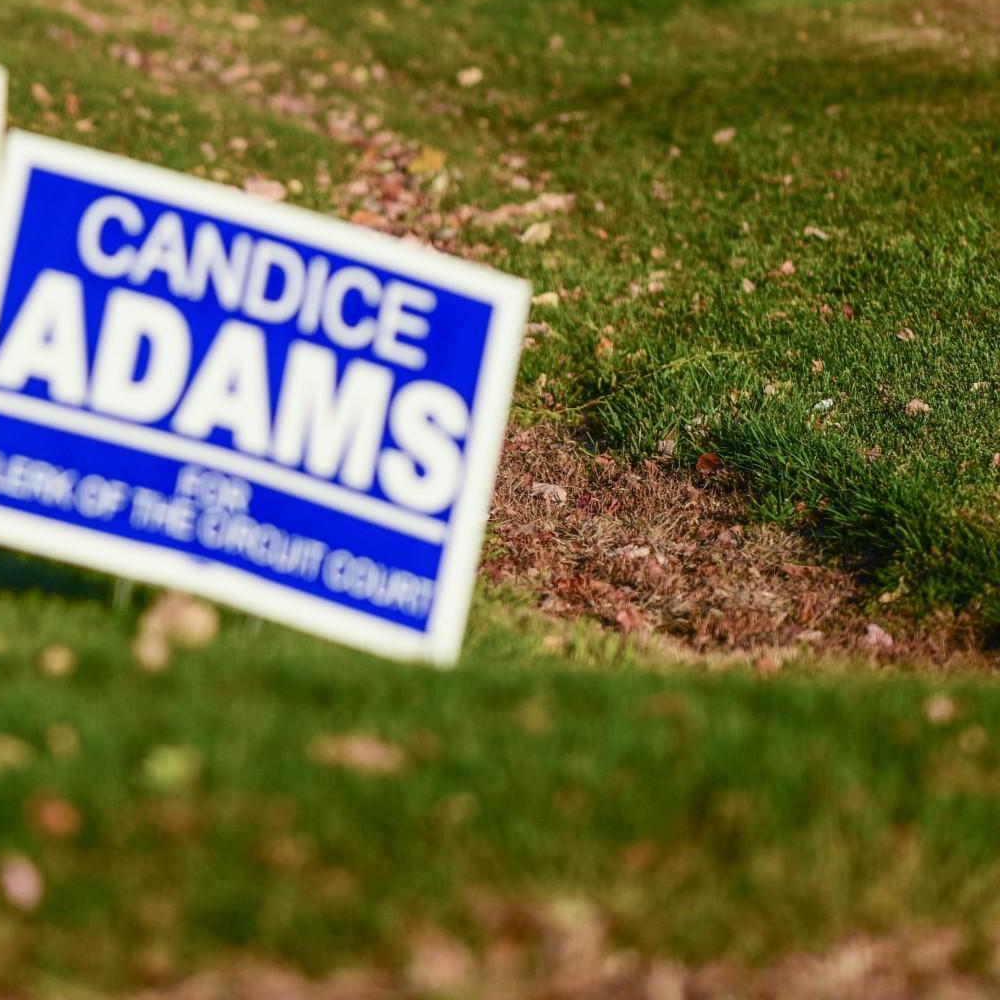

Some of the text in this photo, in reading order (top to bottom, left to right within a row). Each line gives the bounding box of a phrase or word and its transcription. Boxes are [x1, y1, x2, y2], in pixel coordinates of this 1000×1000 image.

[76, 194, 438, 370] CANDICE
[73, 473, 136, 523] OF
[130, 486, 201, 544] THE
[196, 505, 331, 583] CIRCUIT
[321, 548, 438, 622] COURT
[175, 462, 254, 516] FOR
